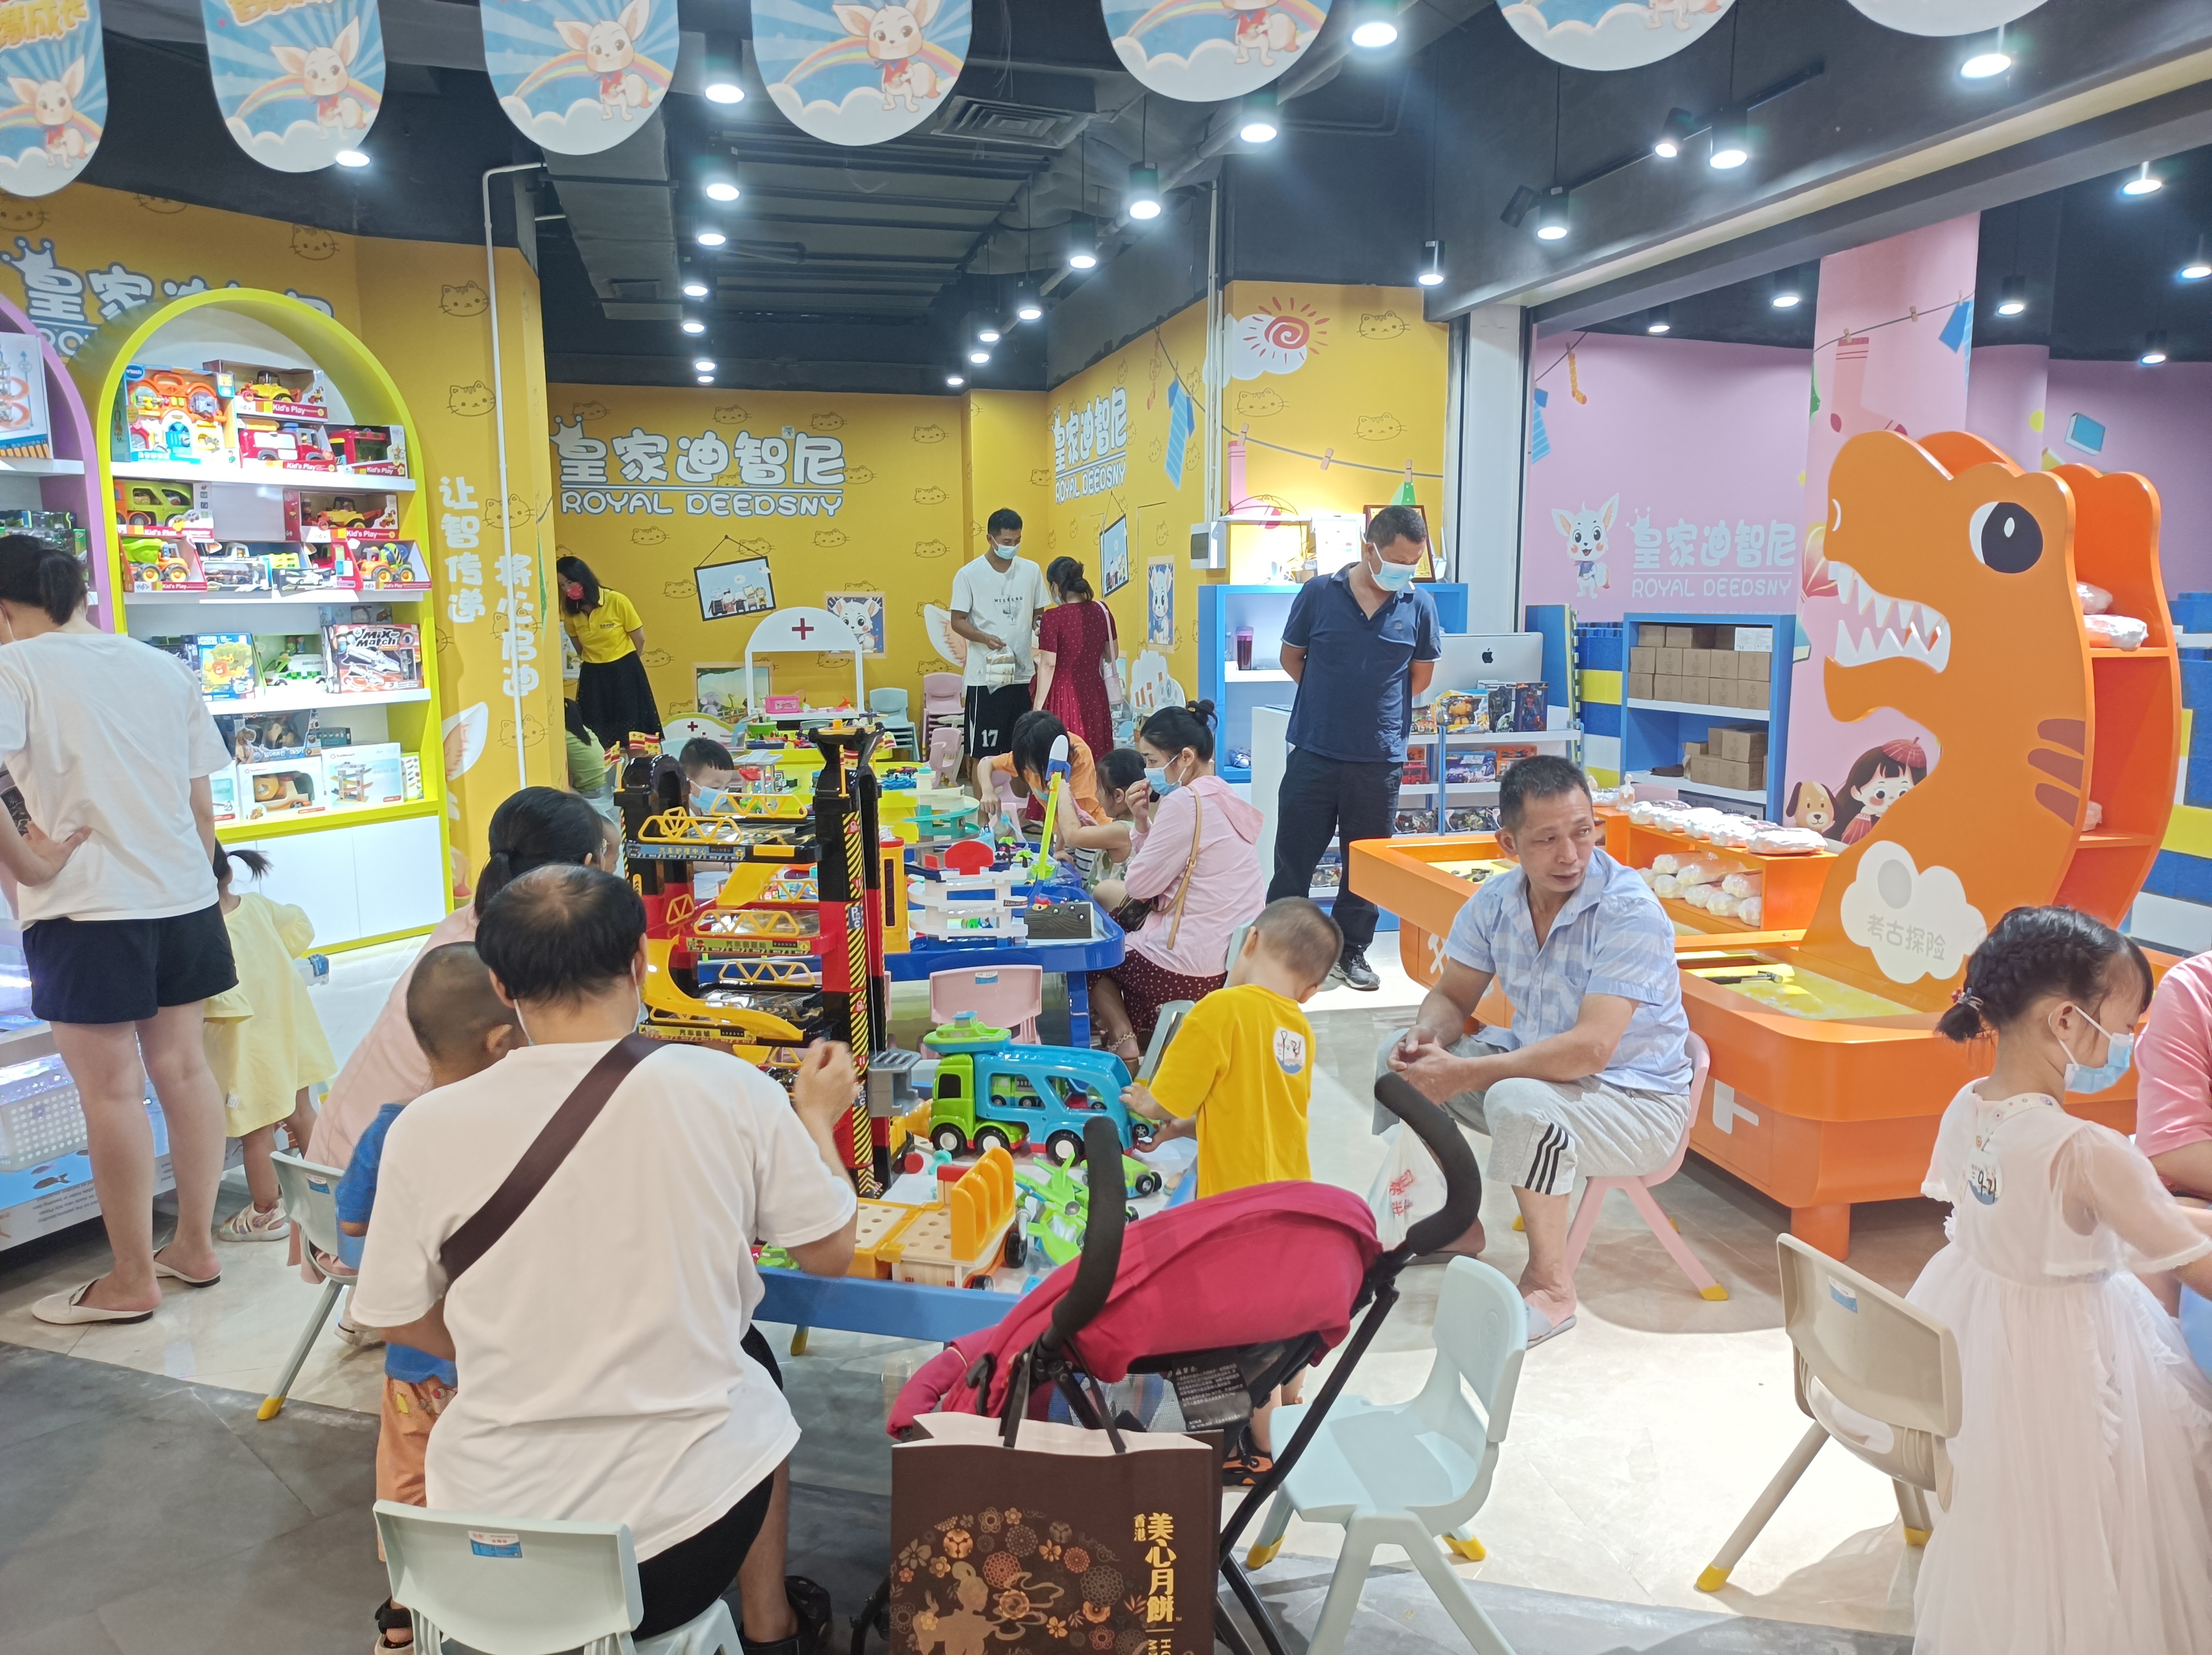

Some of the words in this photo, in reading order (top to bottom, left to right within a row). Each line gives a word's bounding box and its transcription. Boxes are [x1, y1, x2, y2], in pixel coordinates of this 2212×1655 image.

[273, 403, 290, 413] Kid's
[291, 406, 305, 415] Play
[1052, 386, 1127, 473] 皇家迪智尼
[550, 415, 846, 485] 皇家迪智尼
[561, 490, 674, 515] ROYAL
[686, 493, 843, 517] DEEDSNY
[1055, 475, 1079, 505] ROYAL
[1083, 459, 1126, 495] DEEDSNY
[363, 530, 377, 539] Play
[439, 476, 486, 623] 让智传递
[1626, 507, 1796, 568] 皇家迪智尼
[1632, 578, 1694, 598] ROYAL
[1703, 578, 1792, 597] DEEDSNY
[981, 730, 999, 747] 17
[1867, 914, 1945, 960] 考古探险
[1145, 1513, 1177, 1623] 美心月餅
